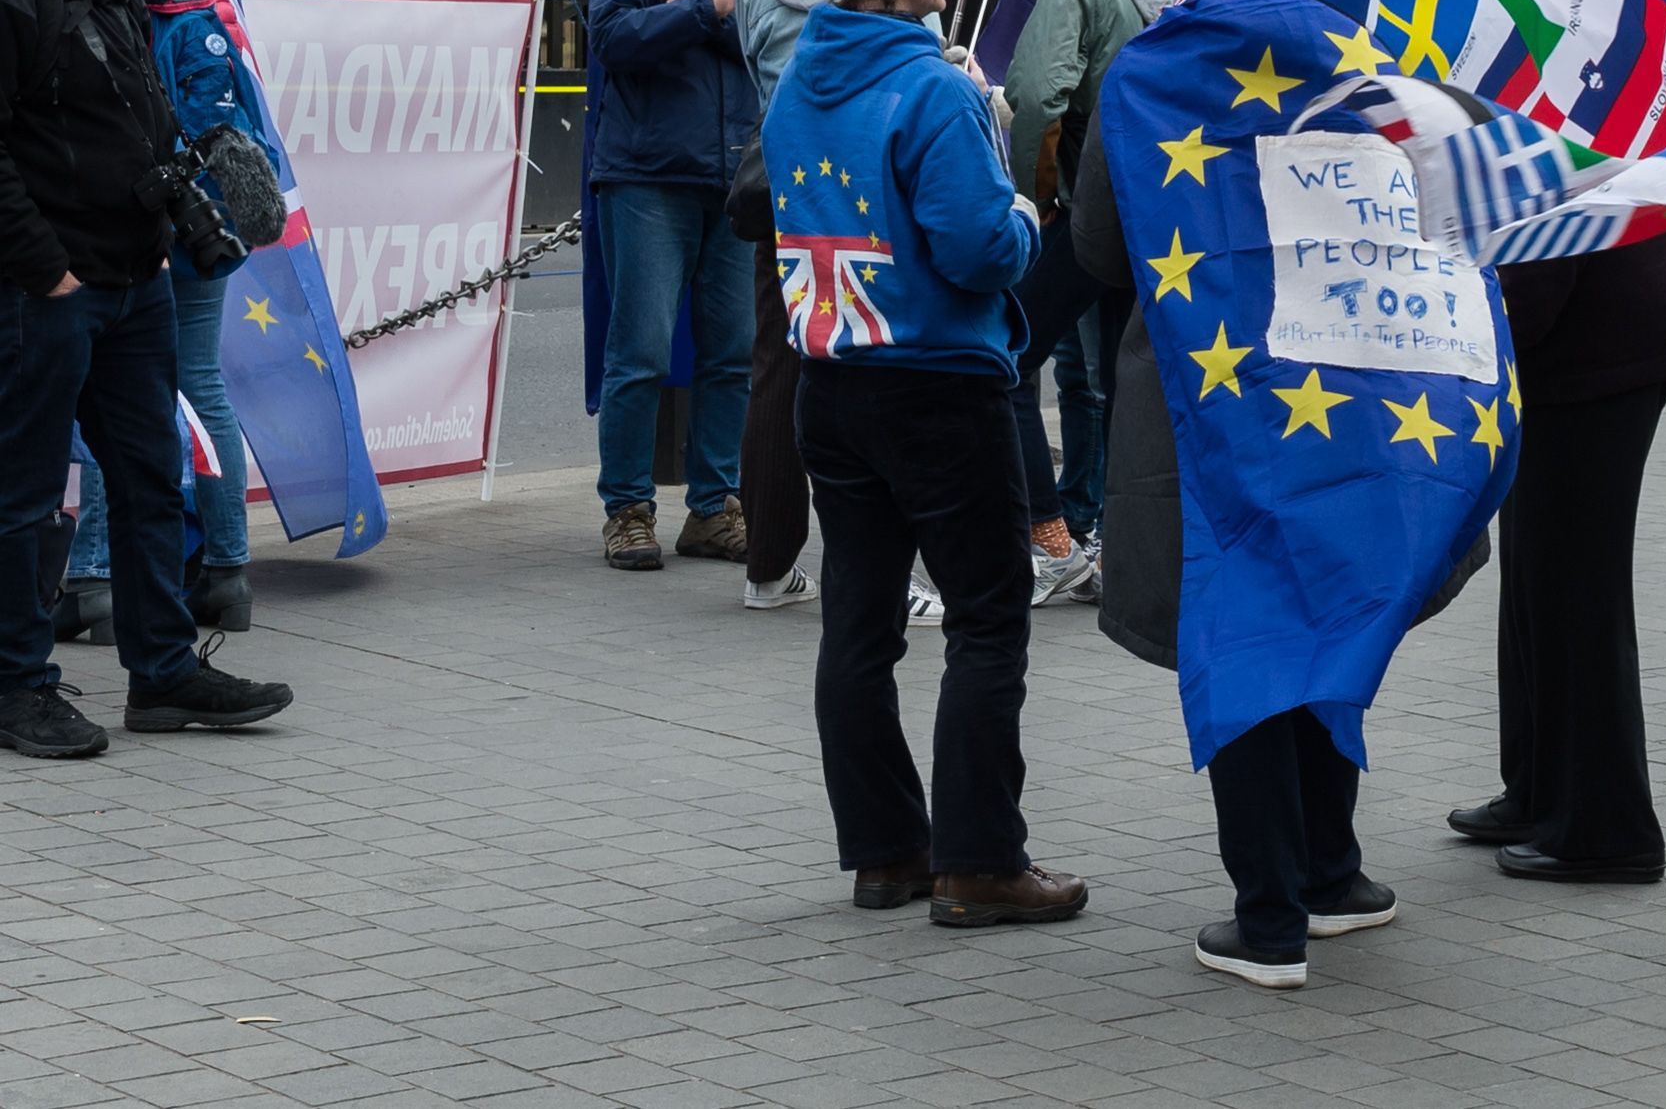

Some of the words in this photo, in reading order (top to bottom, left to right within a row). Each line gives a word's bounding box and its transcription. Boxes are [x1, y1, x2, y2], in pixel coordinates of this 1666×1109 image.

[1288, 161, 1358, 190] WE
[1345, 197, 1418, 235] THE
[1295, 238, 1455, 277] PEOPLE
[1321, 278, 1458, 328] TOO!
